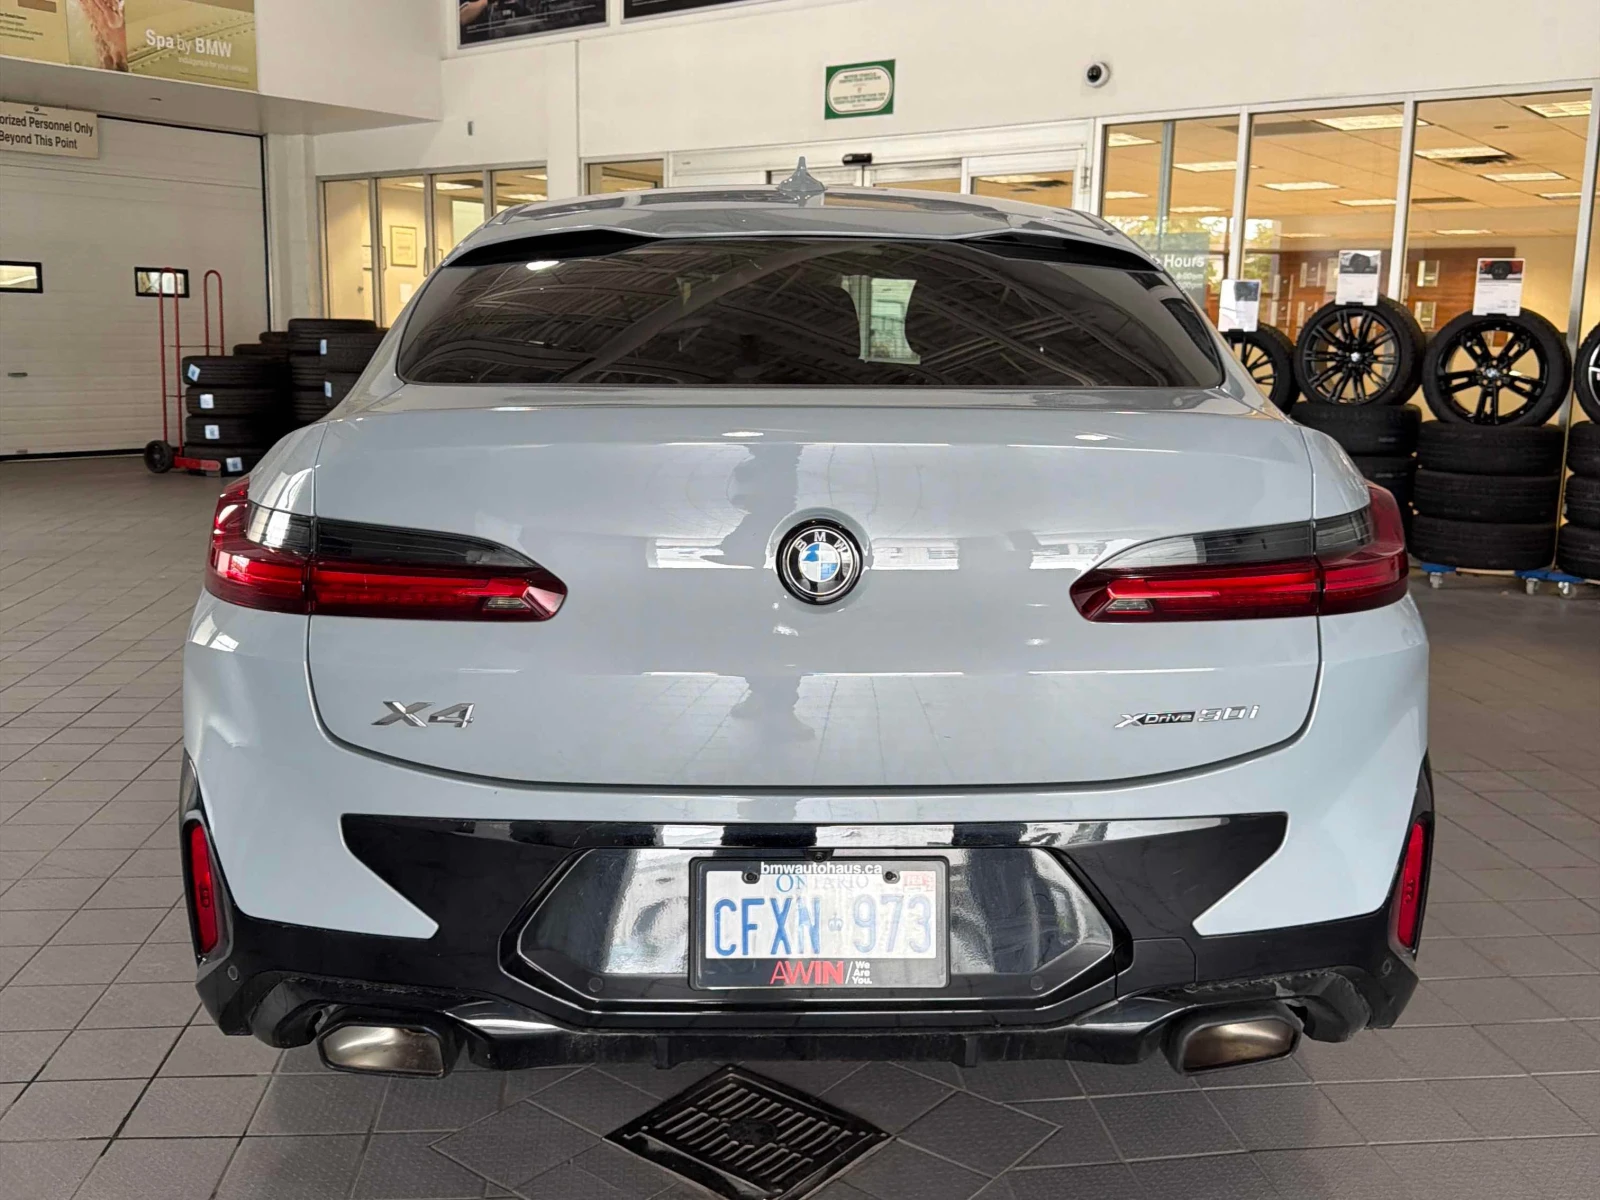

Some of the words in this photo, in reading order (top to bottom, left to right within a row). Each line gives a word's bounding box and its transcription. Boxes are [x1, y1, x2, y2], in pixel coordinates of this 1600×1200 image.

[145, 29, 174, 50] Spa
[177, 34, 192, 55] by
[195, 37, 232, 58] BMW
[29, 116, 73, 132] Personnel
[74, 122, 94, 137] Only
[0, 130, 32, 145] Beyond
[34, 134, 53, 147] This
[55, 136, 78, 150] Point
[1164, 254, 1205, 268] Hours
[795, 531, 848, 553] BMW
[371, 701, 475, 728] X4
[760, 862, 883, 874] bmwautohaus.ca
[714, 897, 821, 956] CFXN
[853, 893, 931, 954] 973
[770, 960, 845, 985] AWIN
[853, 969, 871, 977] Are
[855, 961, 871, 969] We
